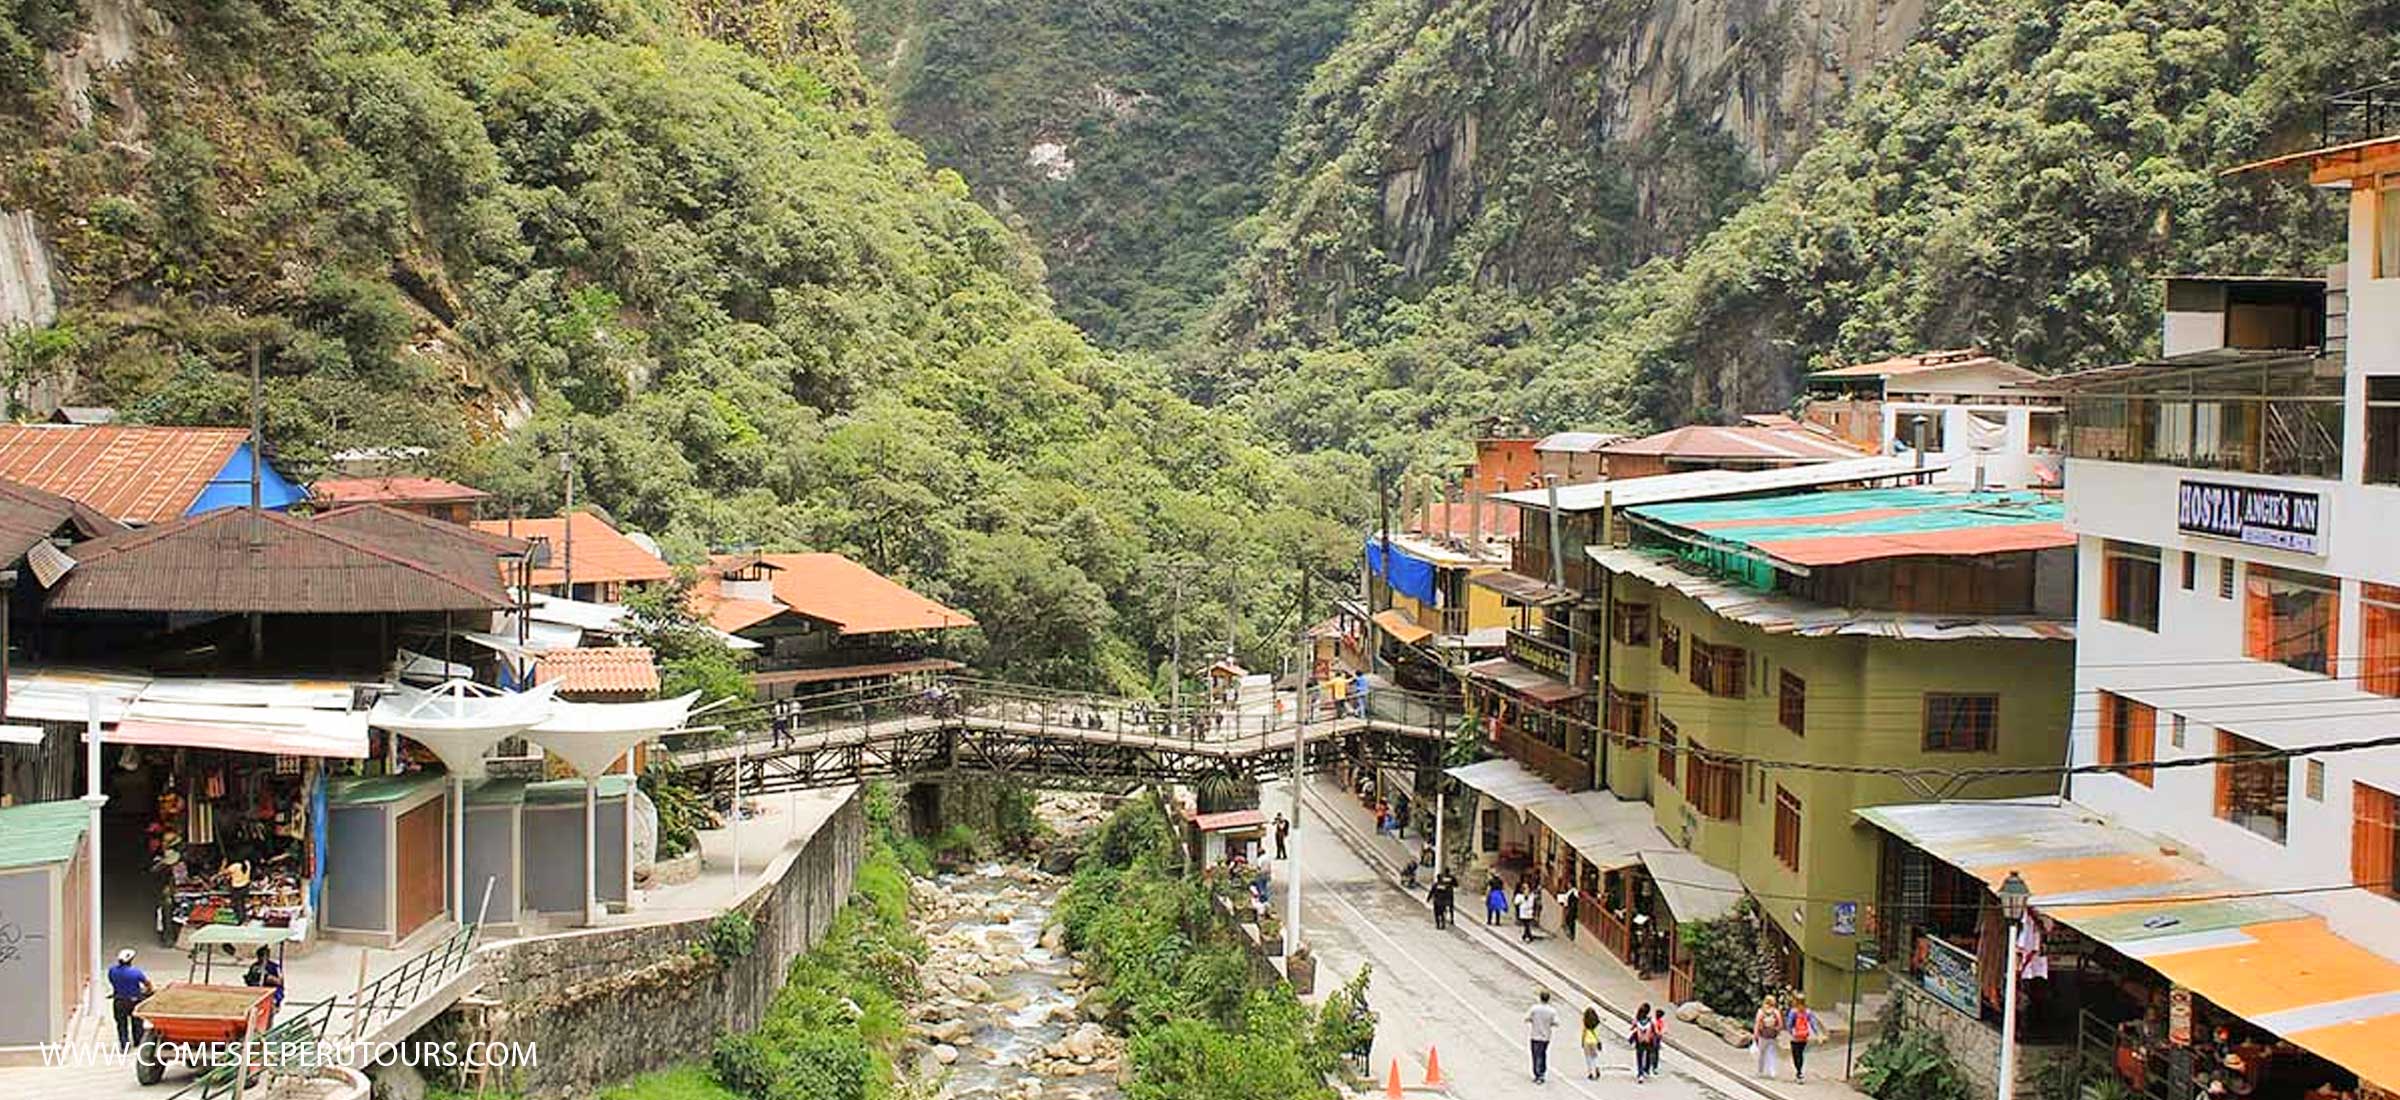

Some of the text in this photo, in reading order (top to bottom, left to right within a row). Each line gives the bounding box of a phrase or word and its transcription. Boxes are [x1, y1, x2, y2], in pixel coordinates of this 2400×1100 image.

[2180, 485, 2317, 532] HOSTAL ANGIE'S INN
